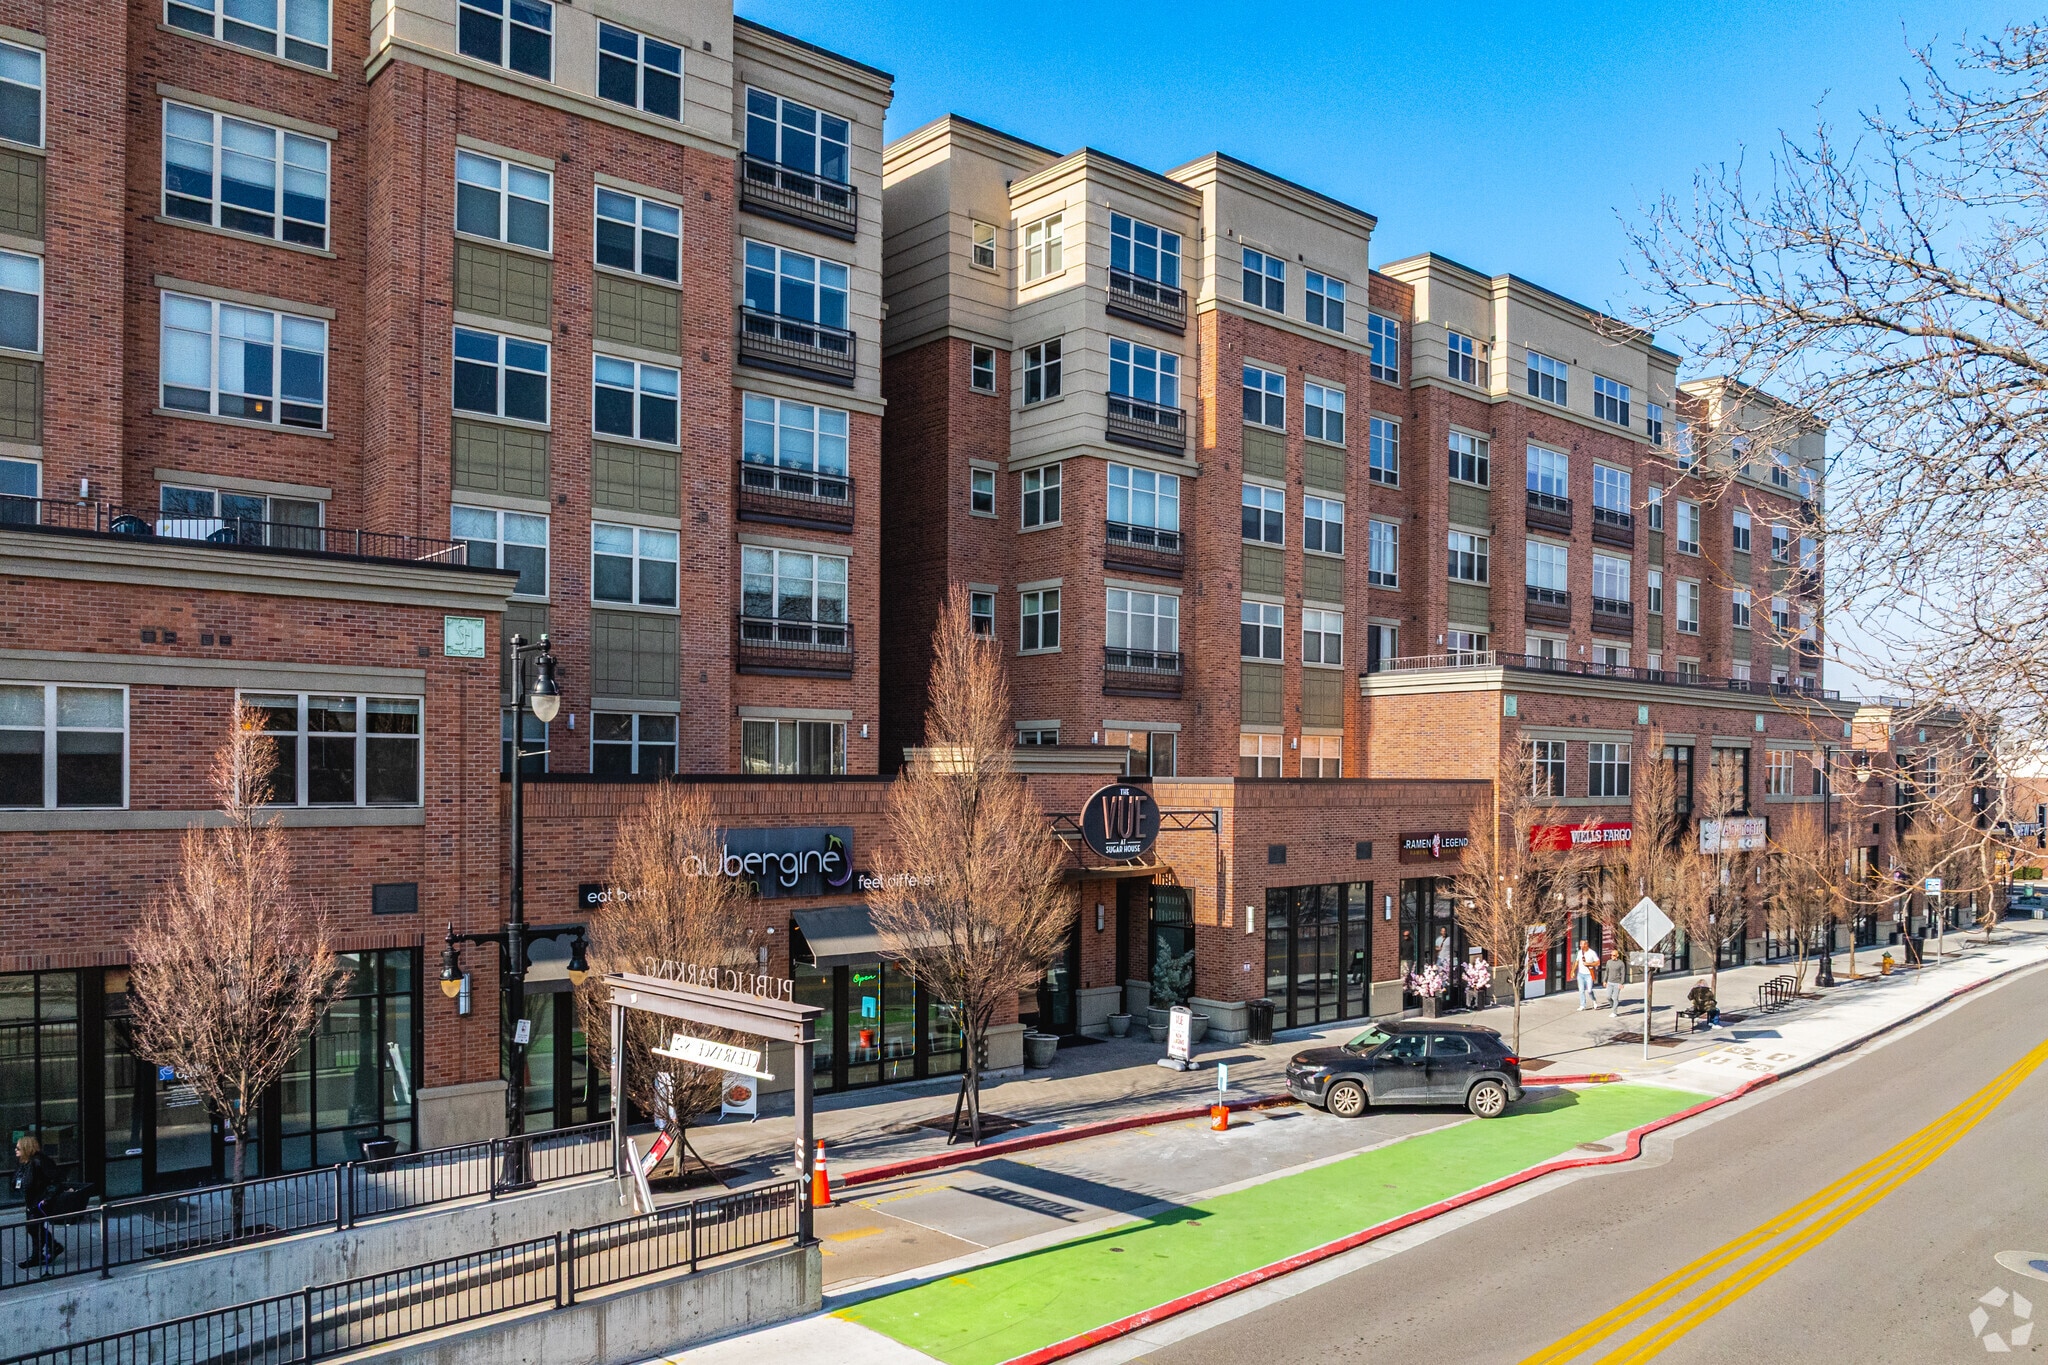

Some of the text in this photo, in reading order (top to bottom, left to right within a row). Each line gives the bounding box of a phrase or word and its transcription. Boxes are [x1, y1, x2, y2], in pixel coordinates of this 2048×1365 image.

[1120, 788, 1130, 796] THE
[1102, 796, 1147, 839] VUE
[1405, 837, 1469, 849] RAMEN LEGEND
[1570, 828, 1632, 844] WELLS FARGO
[1105, 844, 1140, 853] SUGAR HOUSE
[682, 843, 840, 888] aubergine
[858, 874, 883, 890] feel
[587, 887, 613, 903] eat
[852, 973, 877, 987] Open
